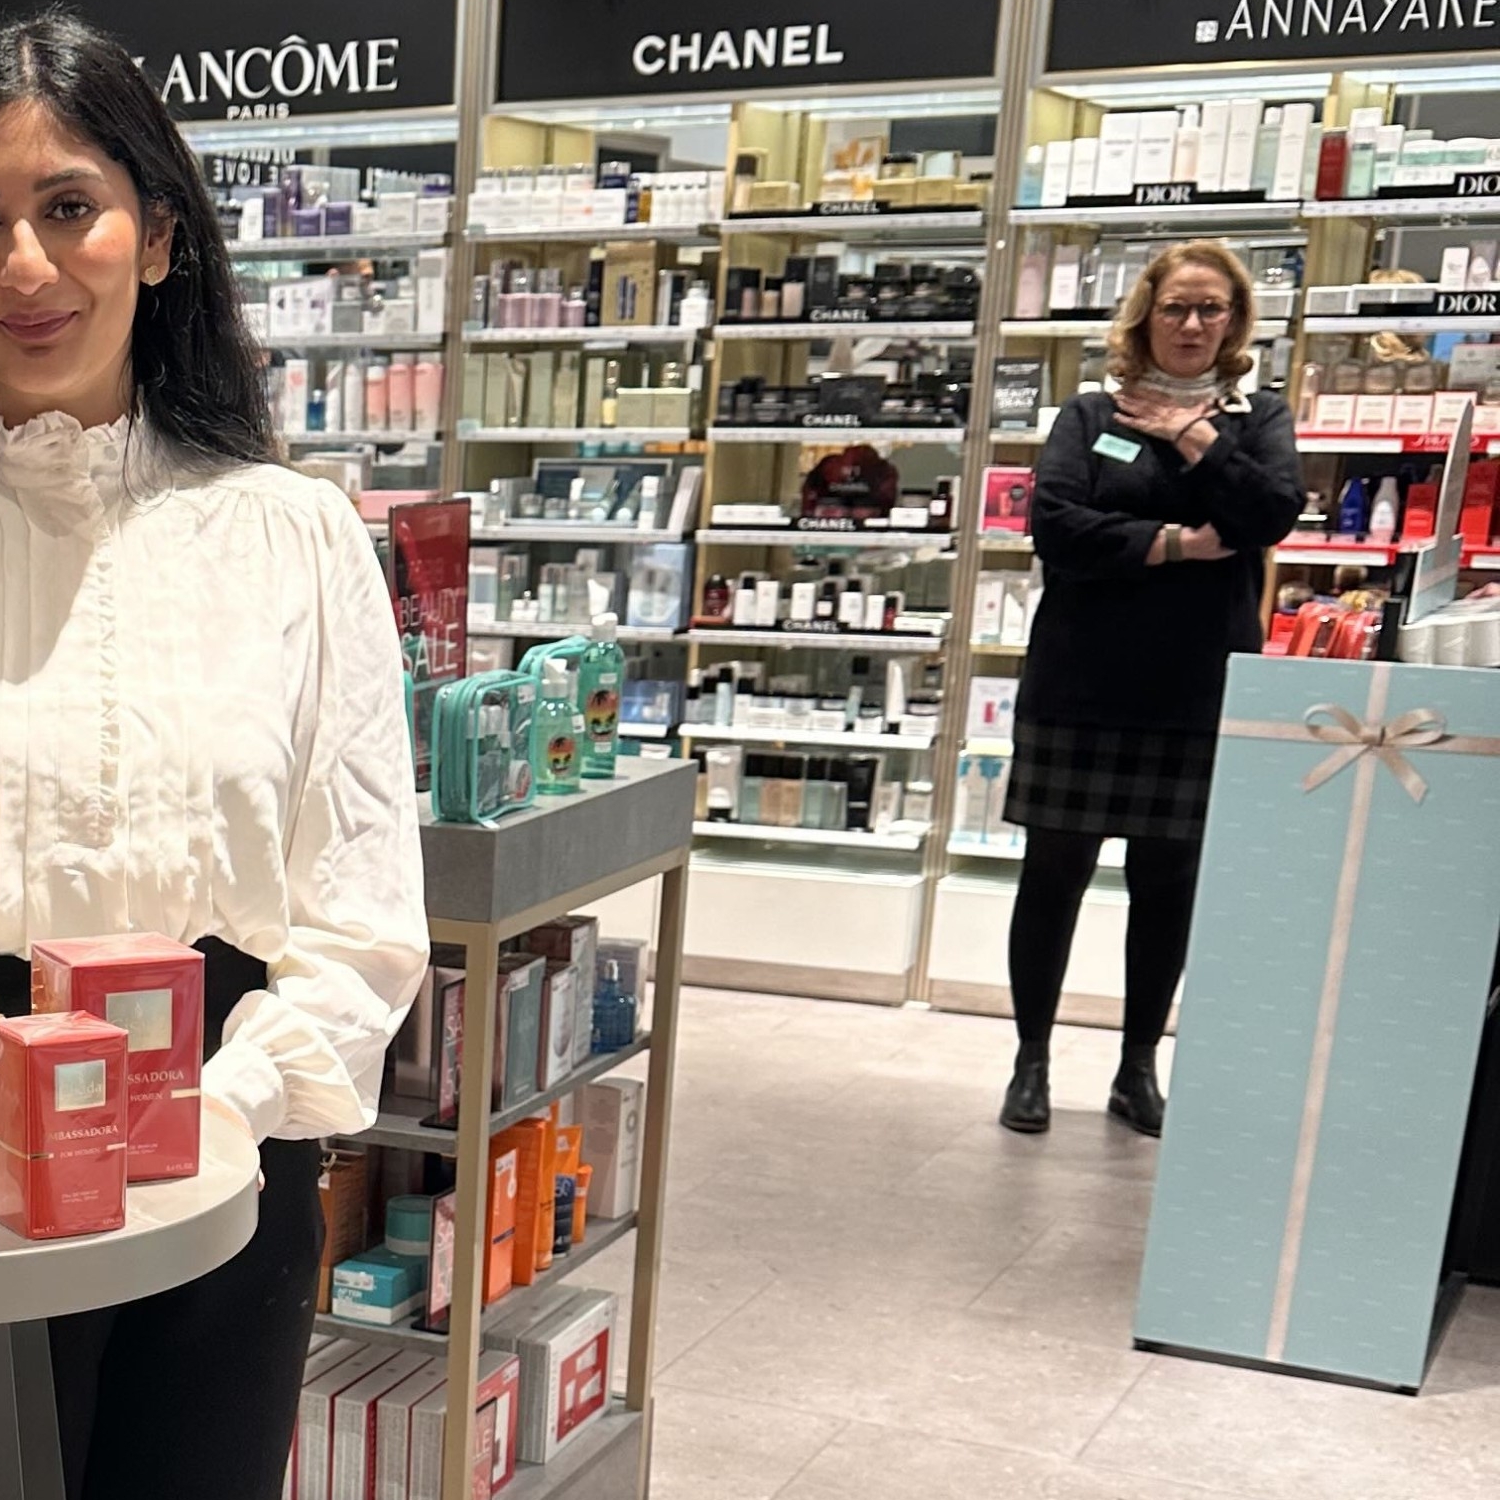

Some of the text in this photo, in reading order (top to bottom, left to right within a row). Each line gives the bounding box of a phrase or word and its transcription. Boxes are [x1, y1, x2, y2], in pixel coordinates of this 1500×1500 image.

[632, 24, 844, 76] CHANEL
[150, 35, 399, 103] ANCÔME
[227, 102, 289, 120] PARIS
[1135, 184, 1192, 204] DIOR
[1458, 175, 1500, 196] DIO
[820, 201, 880, 215] CHANEL
[1437, 294, 1497, 313] DIOR
[810, 309, 871, 323] CHANEL
[803, 414, 862, 428] CHANEL
[799, 517, 857, 531] CHANEL
[400, 587, 465, 629] BEAUTY
[782, 619, 841, 633] CHANEL
[401, 622, 459, 679] SALE
[127, 1068, 185, 1085] SSADORA
[48, 1124, 119, 1142] MBASSADORA
